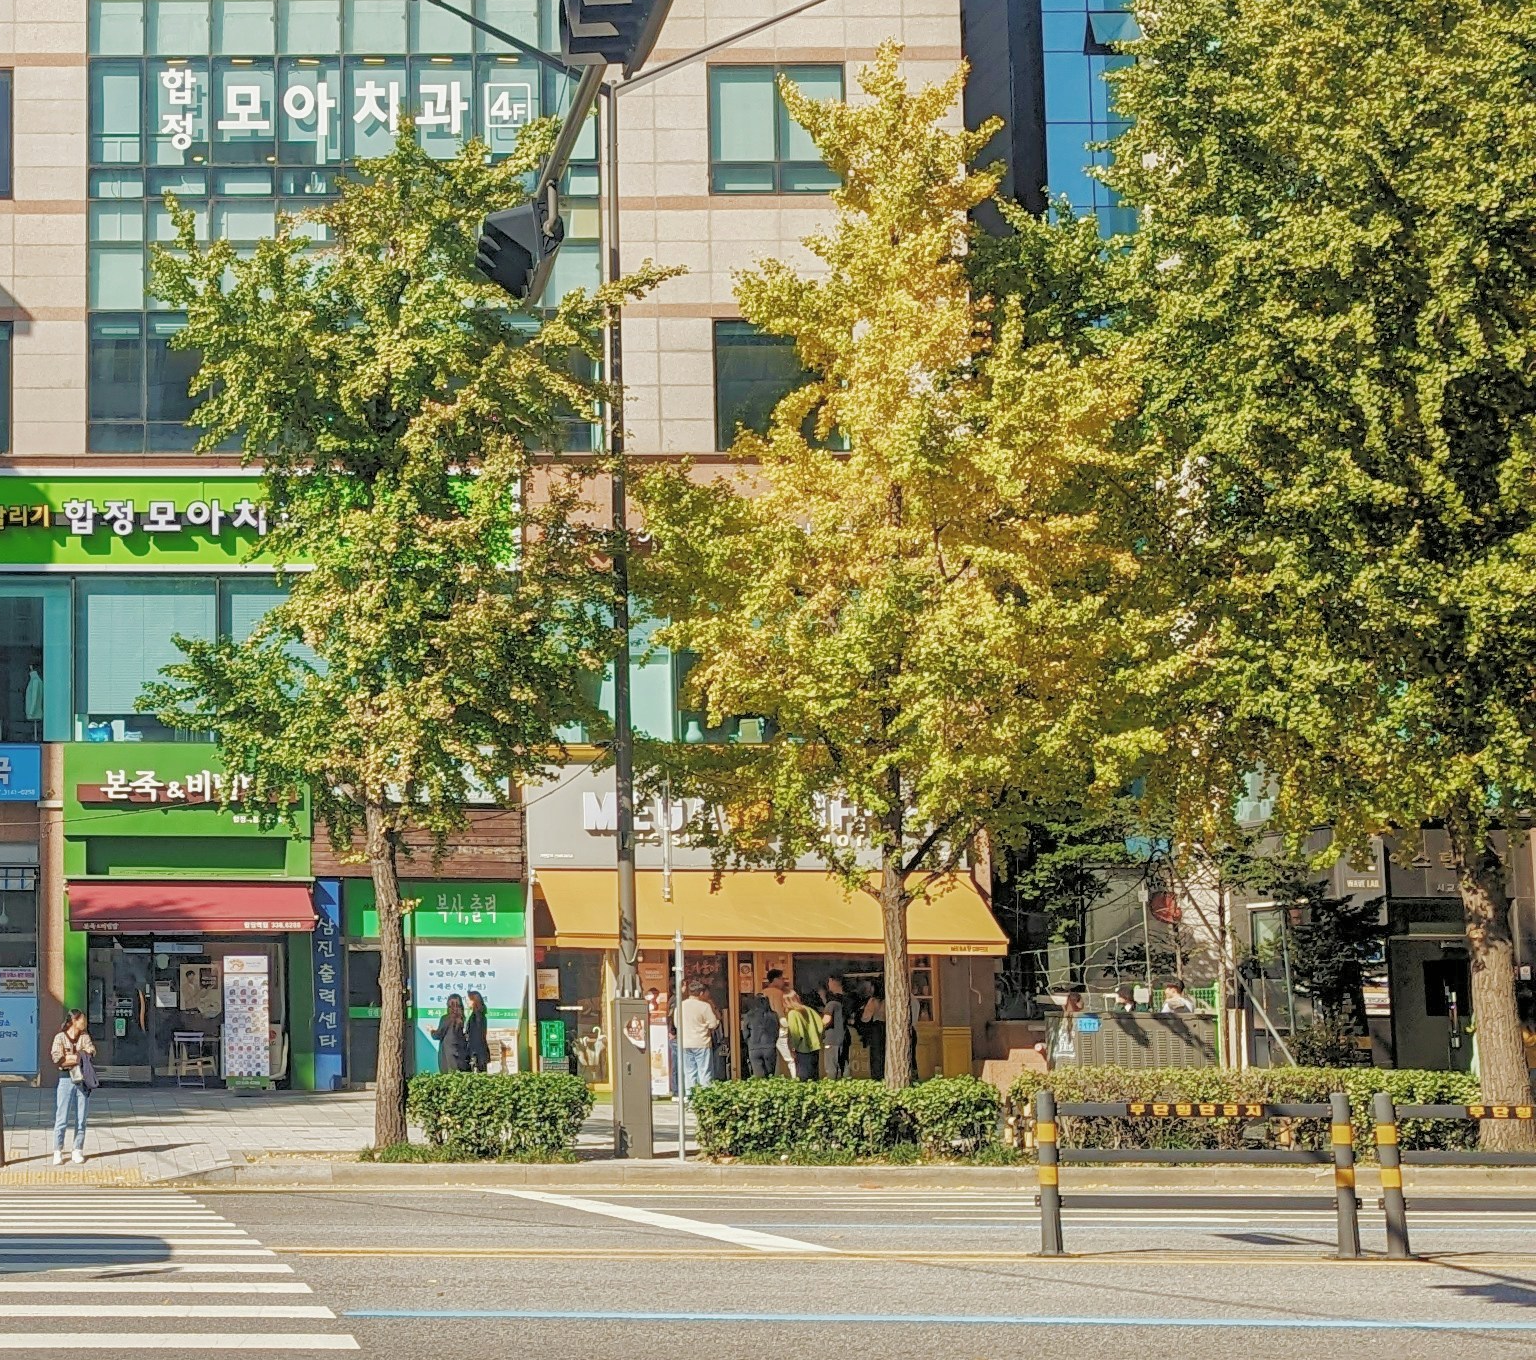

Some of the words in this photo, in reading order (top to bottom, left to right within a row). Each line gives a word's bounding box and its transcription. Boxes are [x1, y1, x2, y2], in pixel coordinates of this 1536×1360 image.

[160, 68, 196, 151] 합정
[217, 80, 468, 137] 모아치과
[490, 91, 527, 122] 4F
[62, 497, 290, 537] 합정모아치
[435, 893, 497, 925] 복사,출력
[316, 917, 338, 1049] 삼진출력센타
[1128, 1104, 1263, 1117] 무단횡단금지
